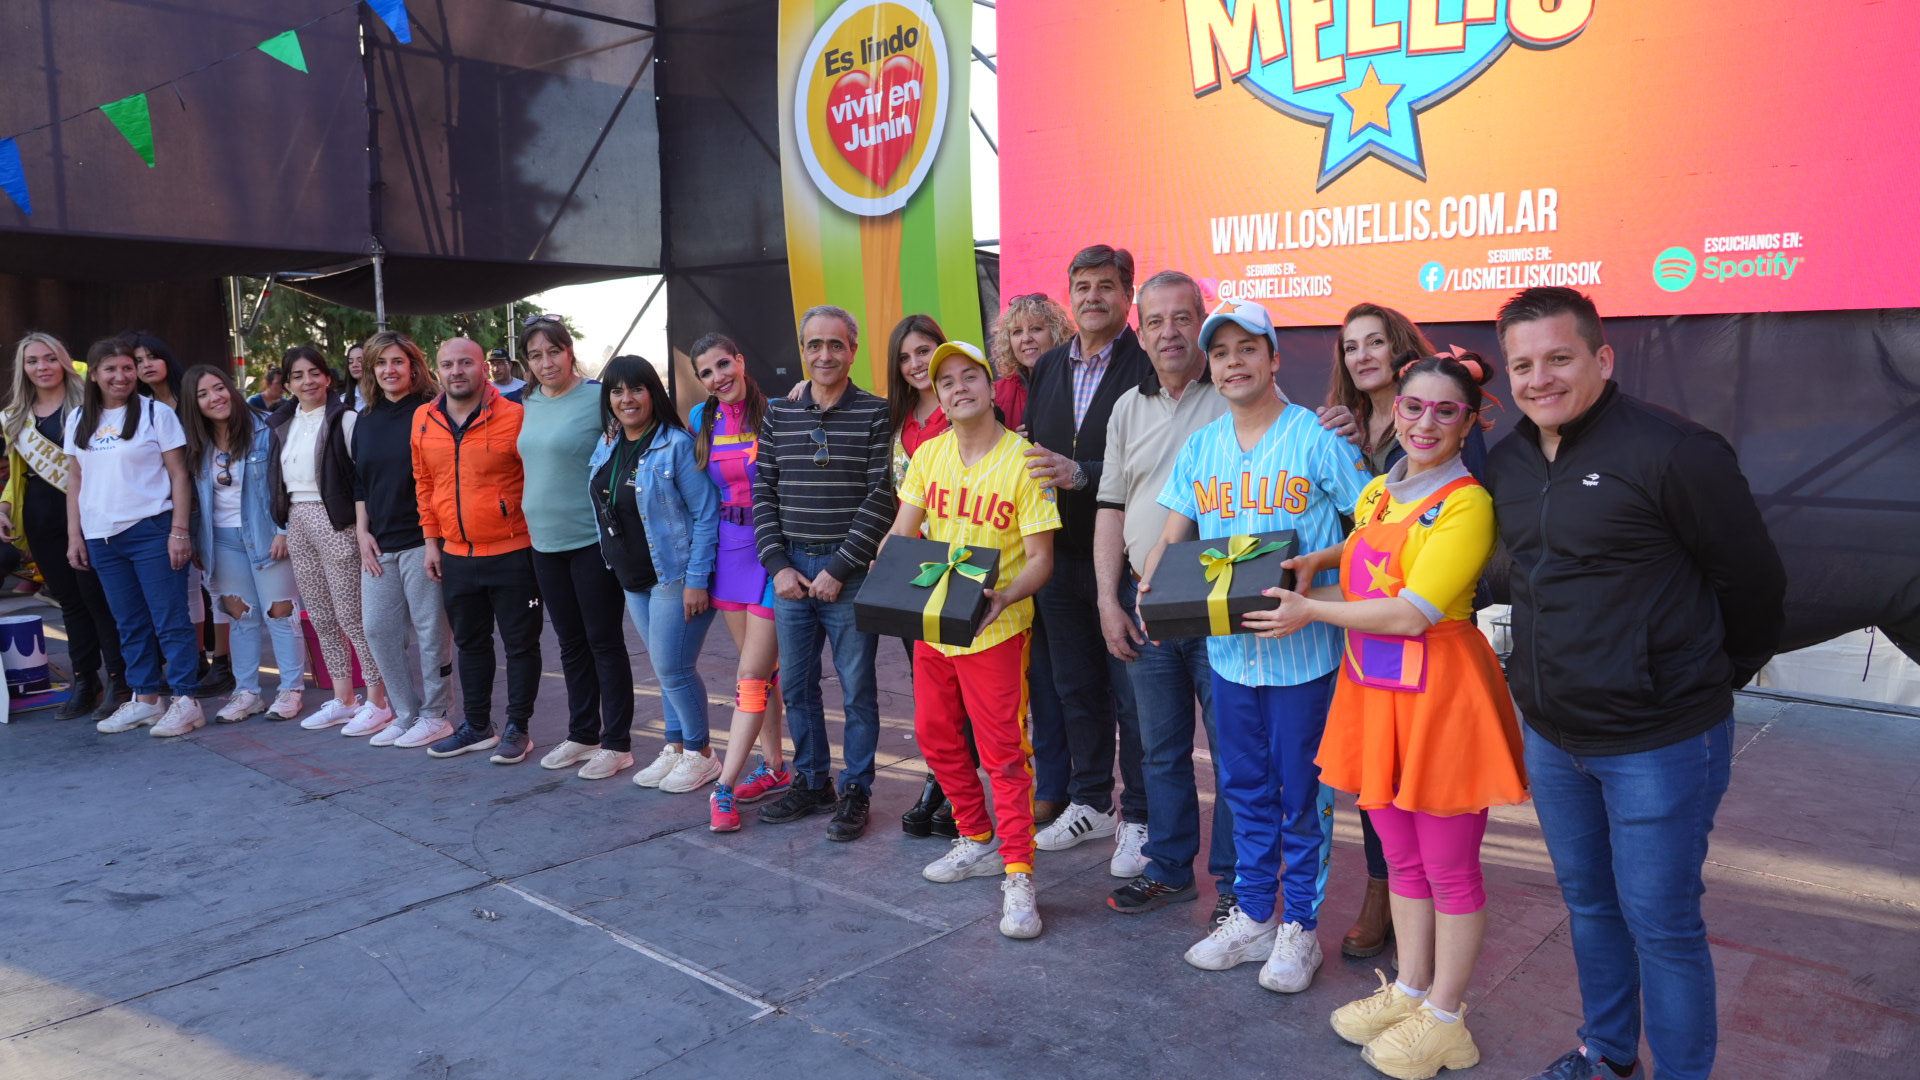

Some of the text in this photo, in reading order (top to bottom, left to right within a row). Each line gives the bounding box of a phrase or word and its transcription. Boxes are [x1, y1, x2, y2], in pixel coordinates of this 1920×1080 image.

[824, 24, 920, 77] Es lindo
[1183, 0, 1596, 98] MELL
[831, 79, 921, 124] vivir en
[844, 111, 912, 151] Junín
[1211, 188, 1558, 255] WWW.LOSMELLIS.COM.AR
[1487, 246, 1552, 263] SEGUINOS EN:
[1704, 232, 1803, 253] ESCUCHANOS EN:
[1246, 262, 1296, 277] SEGUINOS EN:
[1443, 261, 1602, 292] /LOSMELLISKIDSOK
[1702, 252, 1799, 283] Spotify
[1217, 275, 1332, 301] @LOSMELLISKIDS
[24, 452, 68, 490] JUN
[924, 481, 1014, 530] MELLIS
[1193, 470, 1310, 518] MELLIS
